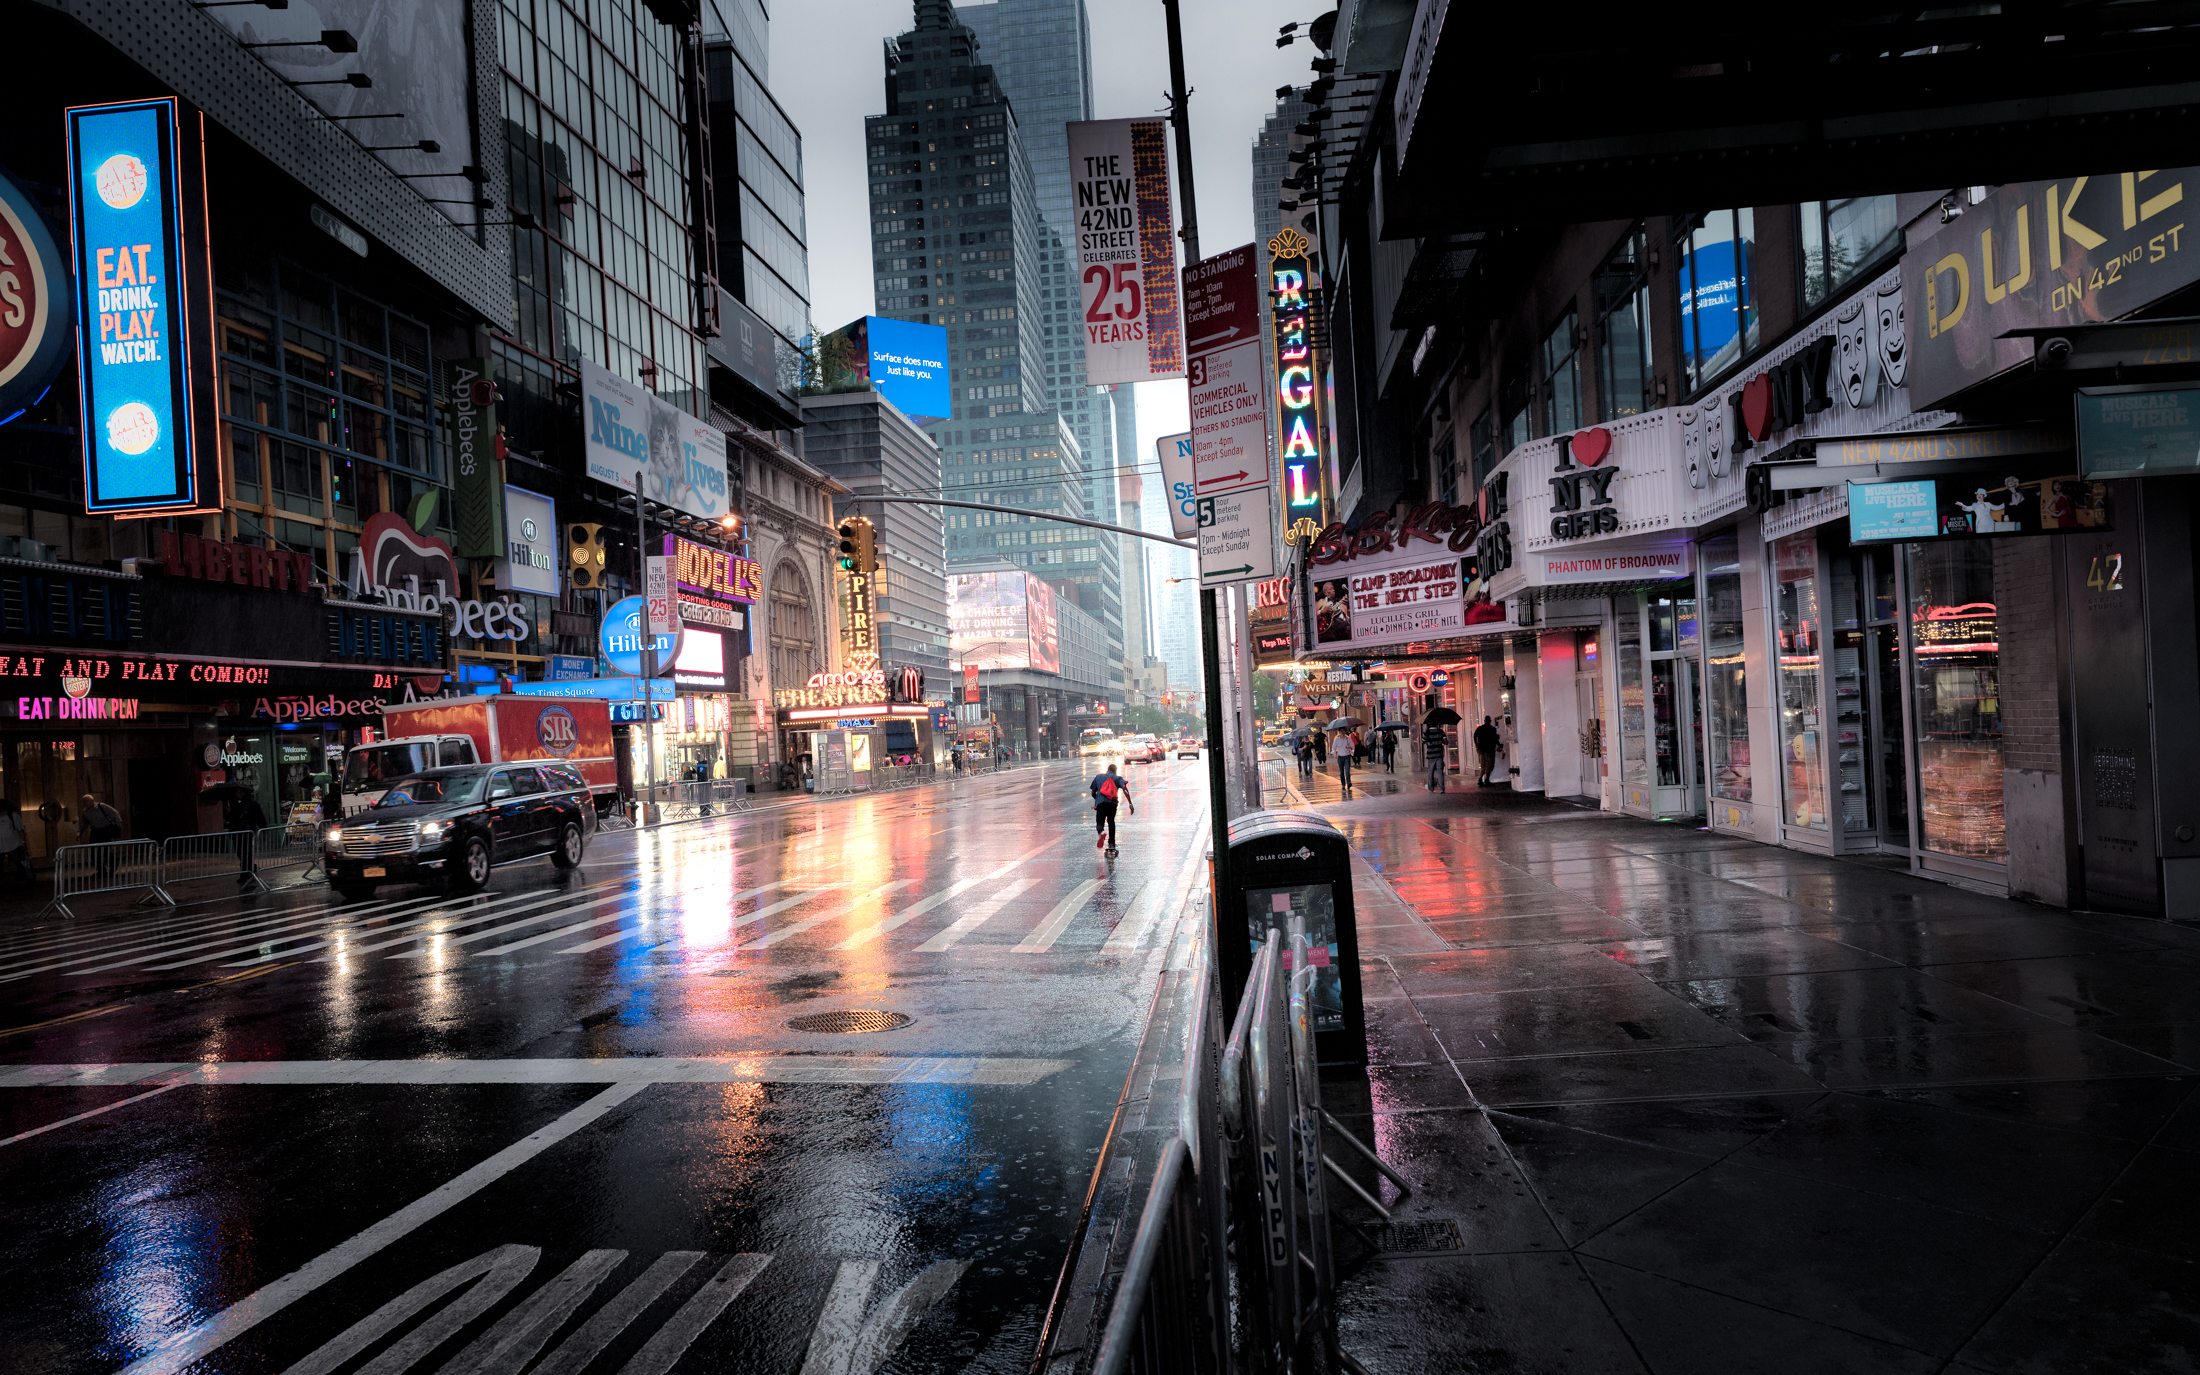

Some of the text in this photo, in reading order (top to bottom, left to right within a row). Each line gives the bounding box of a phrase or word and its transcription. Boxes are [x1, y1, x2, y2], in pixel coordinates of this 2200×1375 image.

[1084, 155, 1120, 178] THE
[1078, 178, 1131, 207] NEW
[1080, 207, 1133, 231] 42ND
[319, 212, 362, 250] LAMAR
[1082, 230, 1135, 250] STREET
[1083, 250, 1136, 263] CELEBRATES
[1925, 169, 2184, 340] DUKE
[97, 244, 157, 289] EAT.
[1185, 253, 1245, 284] NO STANDING
[2051, 223, 2185, 312] ON 42ND ST
[98, 286, 158, 313] DRINK.
[1083, 262, 1142, 323] 25
[1187, 282, 1223, 300] 7am 10am
[1187, 294, 1222, 312] 4pm 7pm
[1188, 301, 1235, 324] Except Sunday
[100, 309, 160, 342] PLAY.
[1087, 321, 1144, 344] YEARS
[2141, 329, 2192, 365] 229
[873, 351, 943, 369] Surface does more.
[1207, 354, 1220, 365] hour
[1208, 360, 1232, 373] metered
[887, 365, 932, 380] Just like you.
[1192, 360, 1204, 385] 3
[1208, 369, 1230, 384] parking
[1193, 382, 1248, 405] COMMERCIAL
[1273, 269, 1318, 509] REGAL
[1728, 335, 1838, 454] I NY
[1194, 394, 1258, 420] VEHICLES ONLY
[2101, 394, 2178, 411] MUSICALS
[452, 365, 480, 476] Applebee's
[1195, 411, 1263, 436] OTHERS NO STANDING
[2102, 407, 2189, 428] LIVE HERE
[589, 394, 726, 513] Nine Lives
[1195, 437, 1234, 453] 10am 4pm
[1196, 446, 1244, 464] Except Sunday
[1843, 429, 2014, 464] NEW 42ND STREET
[590, 463, 620, 482] AUGUST 5
[1549, 435, 1620, 513] I NY
[2094, 458, 2121, 470] 2016
[1864, 483, 1920, 497] MUSICALS
[1865, 492, 1927, 508] LIVE HERE
[1216, 497, 1230, 506] hour
[1217, 505, 1241, 515] metered
[1200, 500, 1212, 526] 5
[1217, 513, 1239, 525] parking
[1551, 507, 1619, 540] GIFTS
[1201, 527, 1250, 544] 7pm Midnight
[1307, 501, 1480, 569] B.B. King
[1860, 529, 1879, 539] 2016
[511, 541, 550, 570] Hilton
[1202, 540, 1250, 556] Except Sunday
[1476, 521, 1512, 582] GIFTS
[2095, 541, 2114, 553] NEW
[161, 529, 313, 593] LIBERTY
[677, 538, 763, 601] MODELL'S
[1548, 553, 1681, 574] PHANTOM OF BROADWAY
[649, 574, 666, 582] NEW
[1352, 562, 1458, 593] CAMP BROADWAY
[2086, 553, 2123, 592] 42
[352, 545, 529, 641] Applebee's
[677, 592, 733, 611] SPORTING GOODS
[1354, 580, 1457, 609] THE NEXT STEP
[649, 599, 667, 616] 25
[967, 606, 1007, 618] CHANCE
[1010, 605, 1021, 615] OF
[1370, 609, 1441, 625] LUCILLE'S GRILL
[974, 617, 1017, 629] DRIVING.
[1356, 615, 1458, 637] LUNCH DINNER LATE NITE
[338, 612, 439, 662] DINER
[963, 629, 1015, 639] MAZDA CX-9
[1261, 637, 1286, 648] Purge The
[0, 656, 269, 685] EAT AND PLAY COMBO!!
[562, 659, 585, 670] MONEY
[856, 657, 869, 667] 25
[556, 669, 590, 680] EXCHANGE
[861, 669, 886, 685] 25
[1417, 677, 1424, 688] L
[1431, 673, 1448, 682] Lids
[537, 686, 596, 698] Times Square
[775, 685, 887, 708] THEATRES
[967, 682, 977, 692] BOYS
[1304, 683, 1342, 693] WESTIN
[19, 697, 138, 720] EAT DRINK PLAY
[250, 694, 387, 723] Applebee's
[542, 716, 576, 742] SIR
[837, 718, 872, 728] IMAX
[220, 751, 263, 767] Applebee's
[2093, 755, 2136, 769] PERFORMING
[1277, 851, 1315, 860] COMPAR
[1264, 1151, 1286, 1261] NYPD
